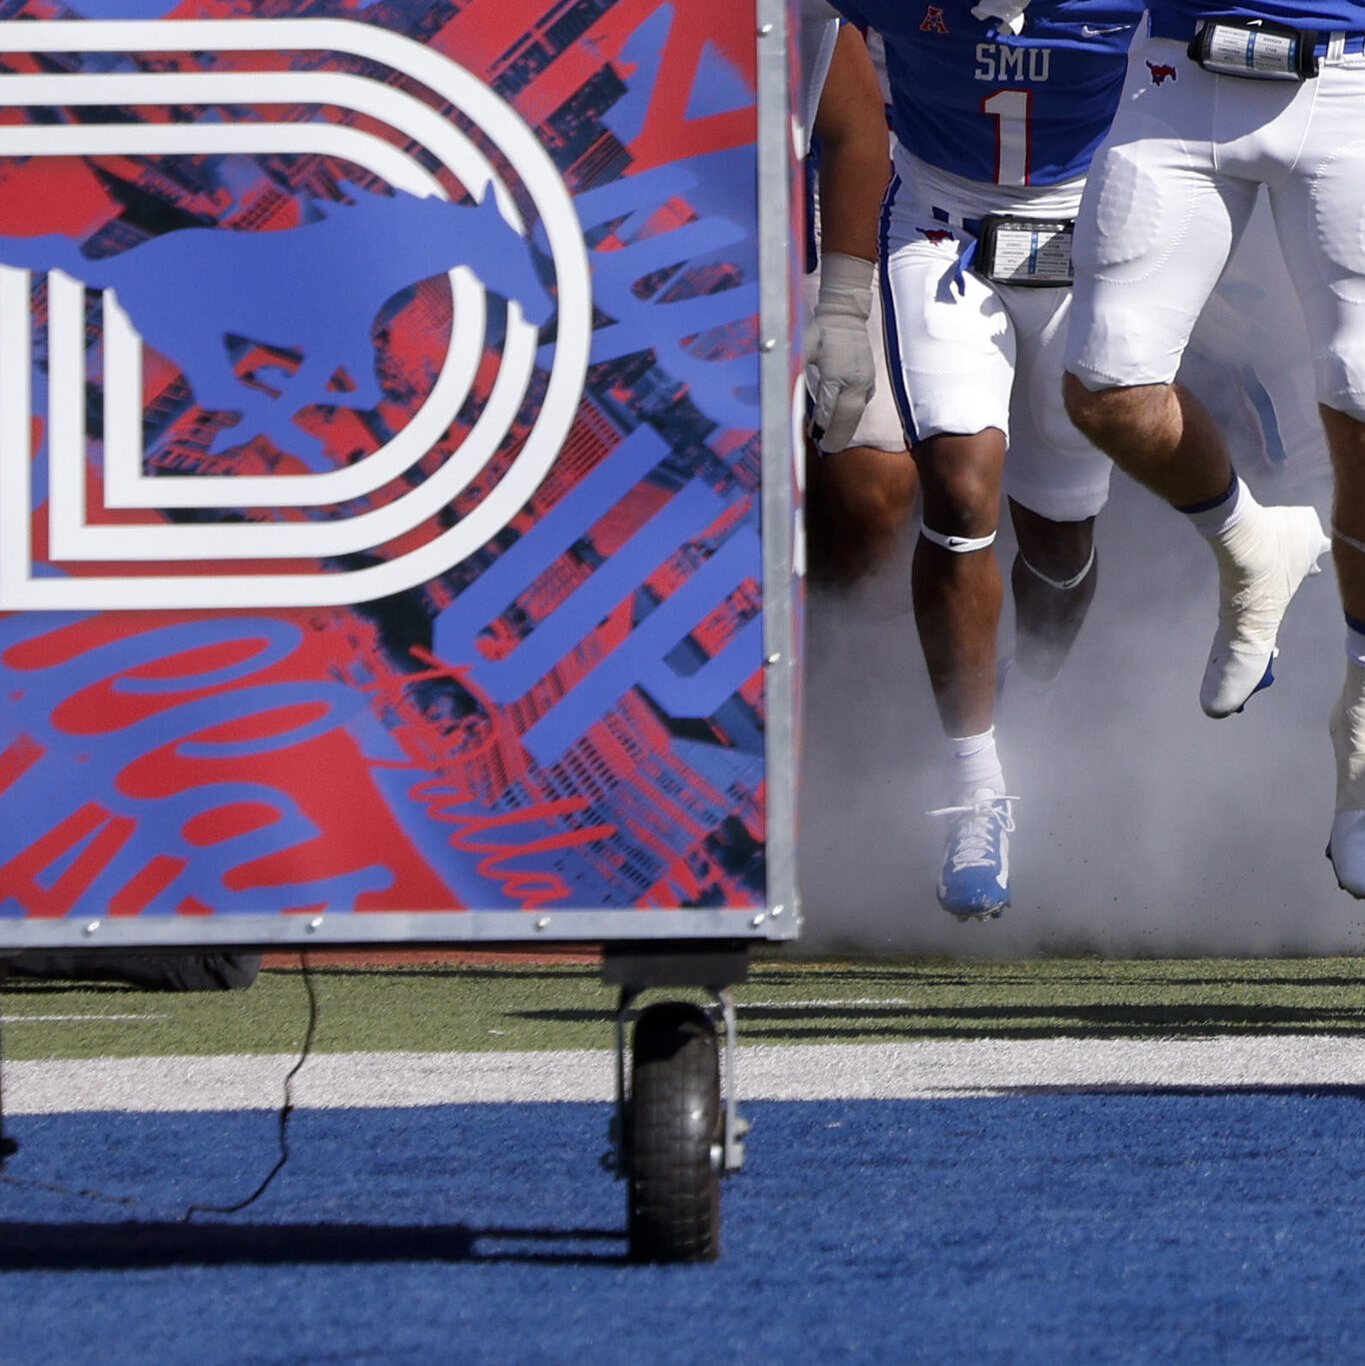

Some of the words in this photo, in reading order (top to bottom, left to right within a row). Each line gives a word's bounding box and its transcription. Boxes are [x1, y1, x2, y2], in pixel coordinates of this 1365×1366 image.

[974, 43, 1050, 82] SMU
[980, 88, 1034, 186] 1
[433, 421, 766, 771] UP
